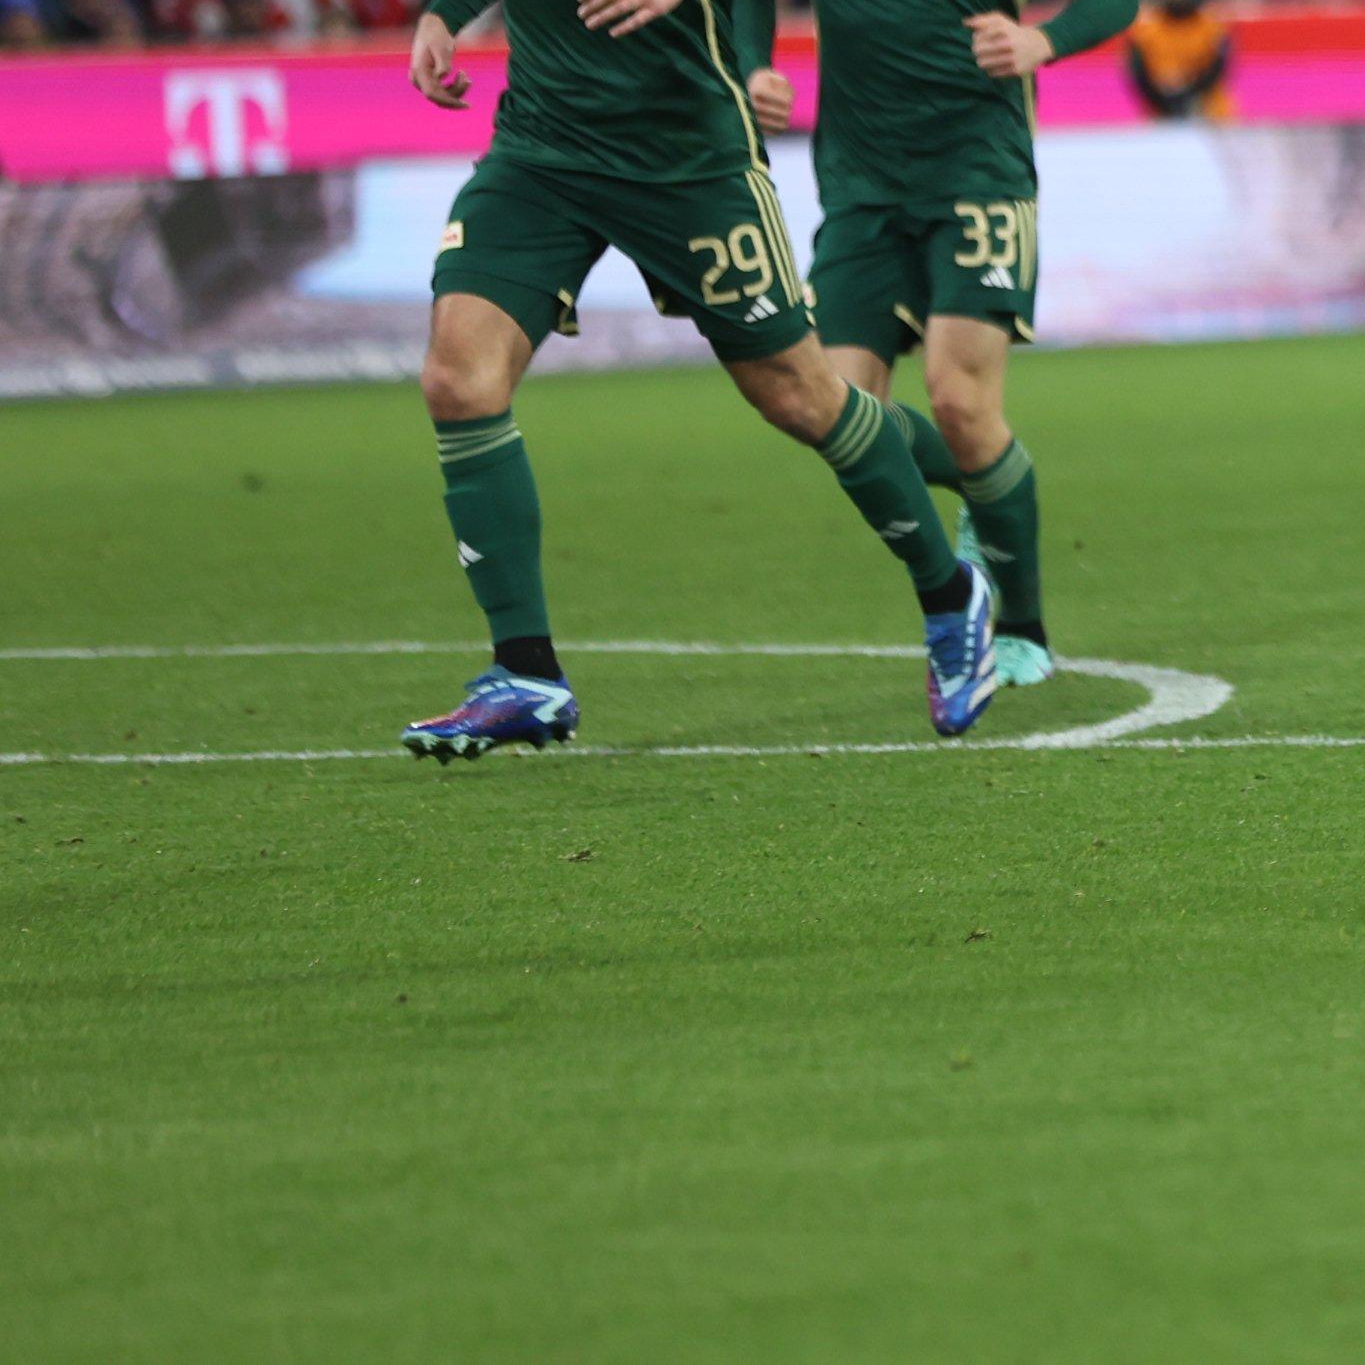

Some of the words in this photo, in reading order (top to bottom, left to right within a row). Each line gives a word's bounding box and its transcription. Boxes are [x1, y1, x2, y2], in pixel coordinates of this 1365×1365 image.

[163, 68, 290, 181] T
[687, 222, 774, 306] 29
[953, 201, 1018, 268] 33
